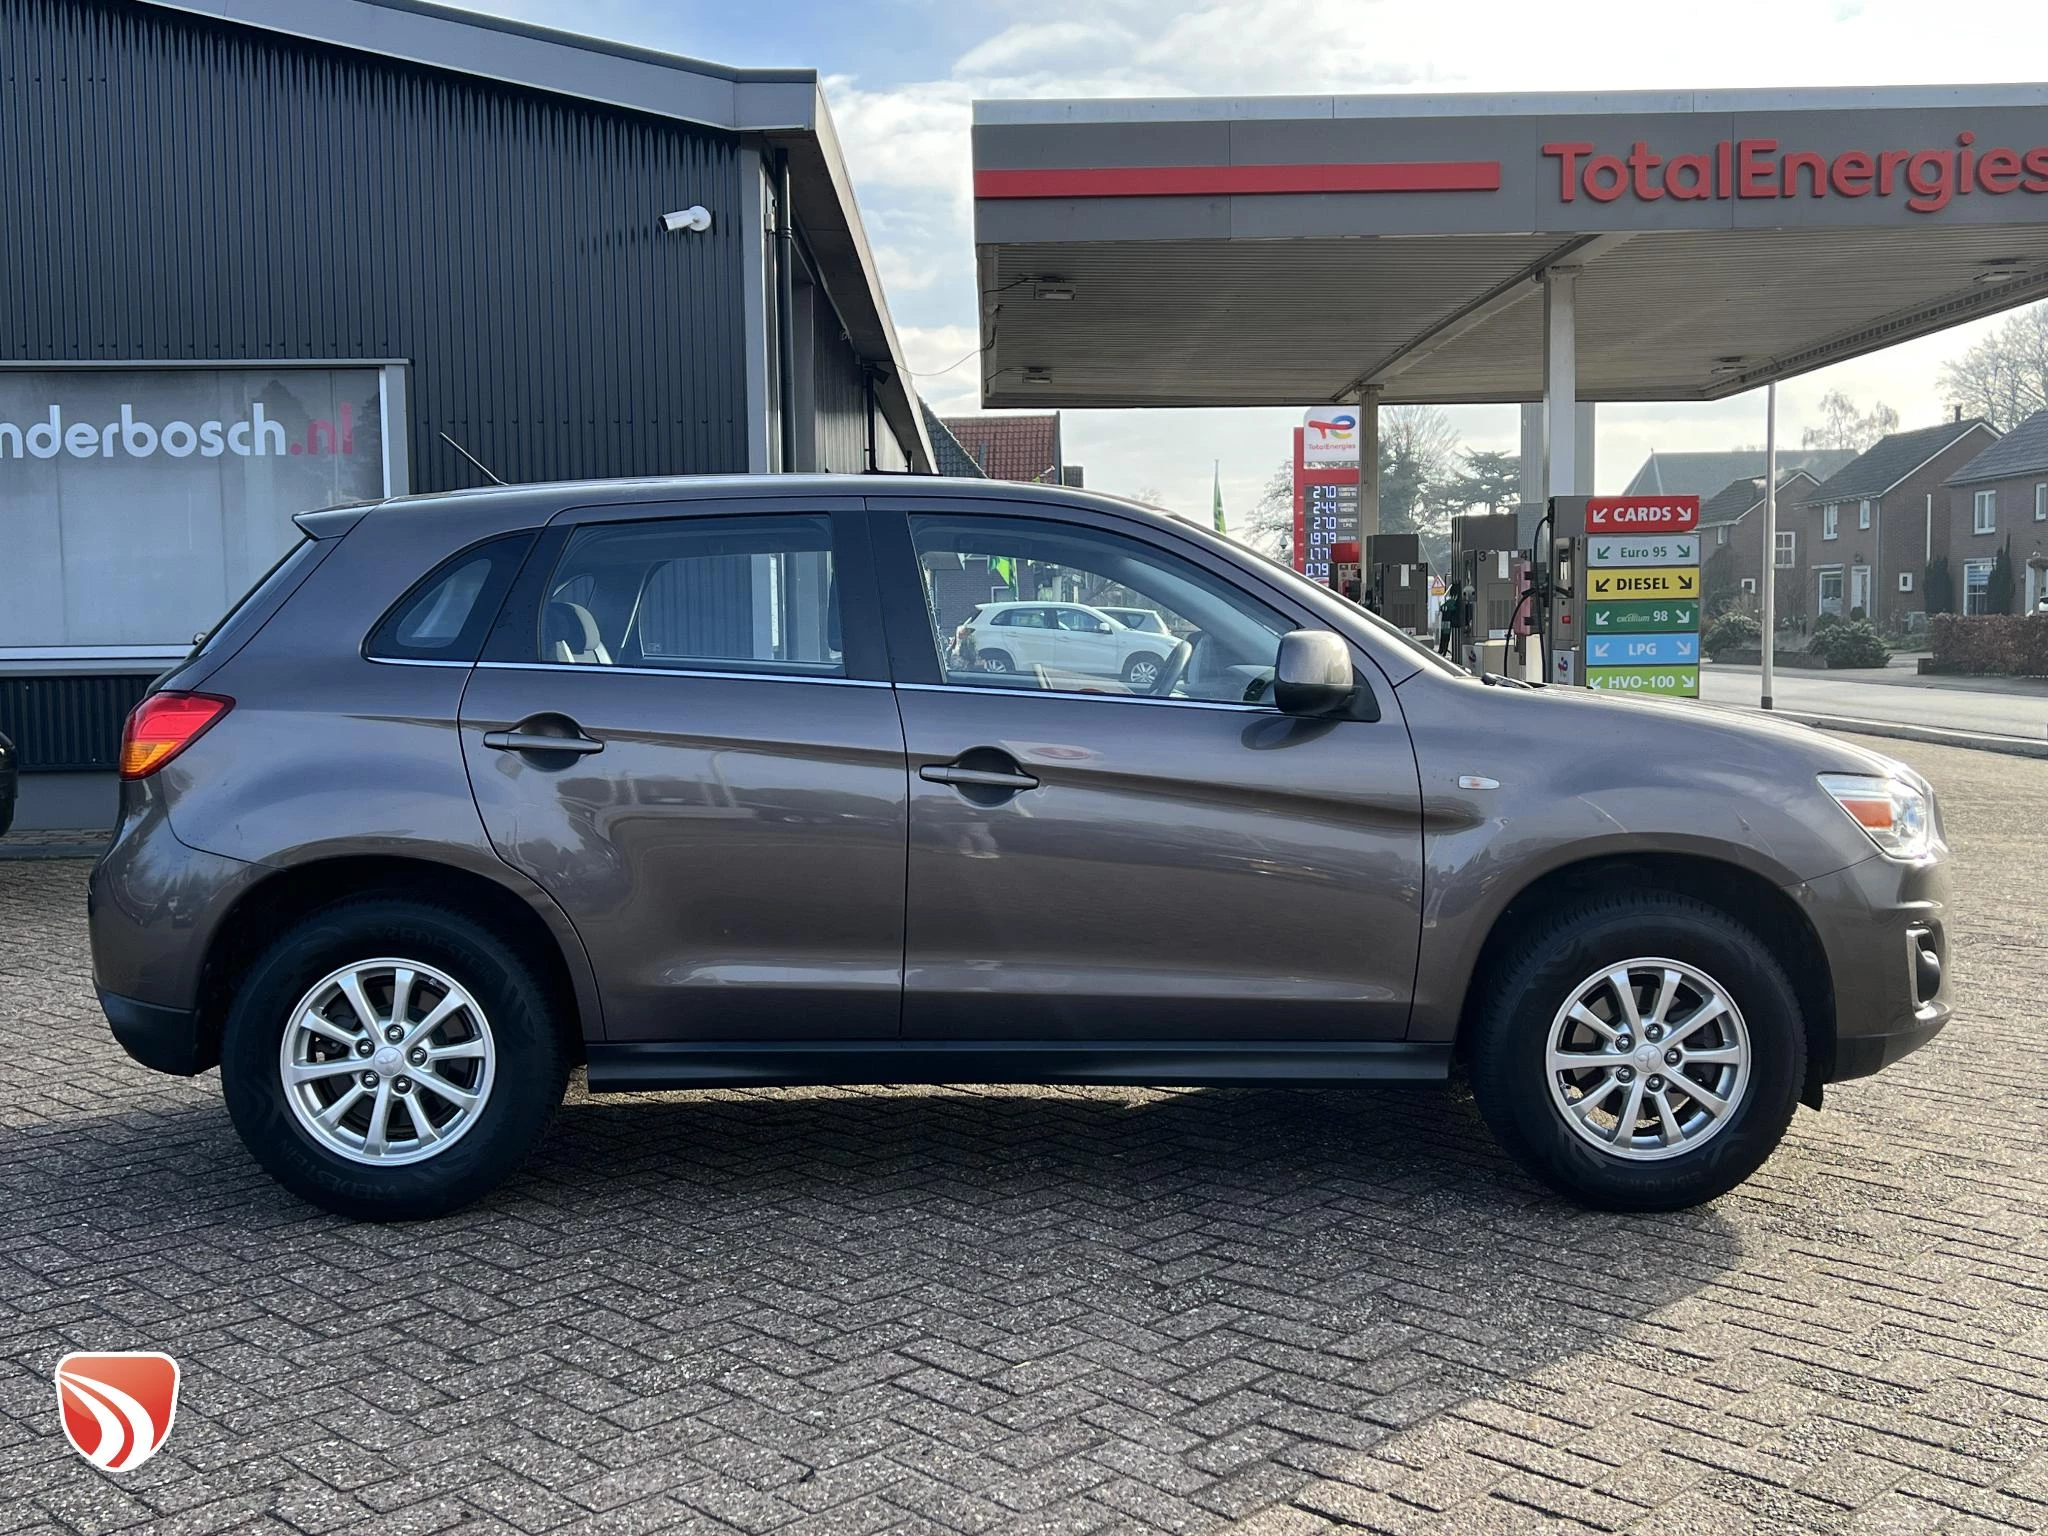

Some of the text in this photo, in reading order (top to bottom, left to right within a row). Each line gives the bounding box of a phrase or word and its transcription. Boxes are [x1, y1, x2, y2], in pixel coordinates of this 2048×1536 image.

[1542, 130, 2048, 213] TotalEnergies
[0, 401, 353, 459] nderbosch.nl
[1613, 506, 1672, 522] CARDS
[1310, 548, 1332, 560] 1.77
[1478, 550, 1487, 562] 3
[1520, 550, 1529, 561] 4
[1620, 546, 1668, 558] Euro 95
[1418, 564, 1425, 572] 2
[1616, 577, 1670, 591] DIESEL
[1653, 610, 1668, 622] 98
[1628, 643, 1657, 656] LPG
[1608, 675, 1675, 689] HVO-100
